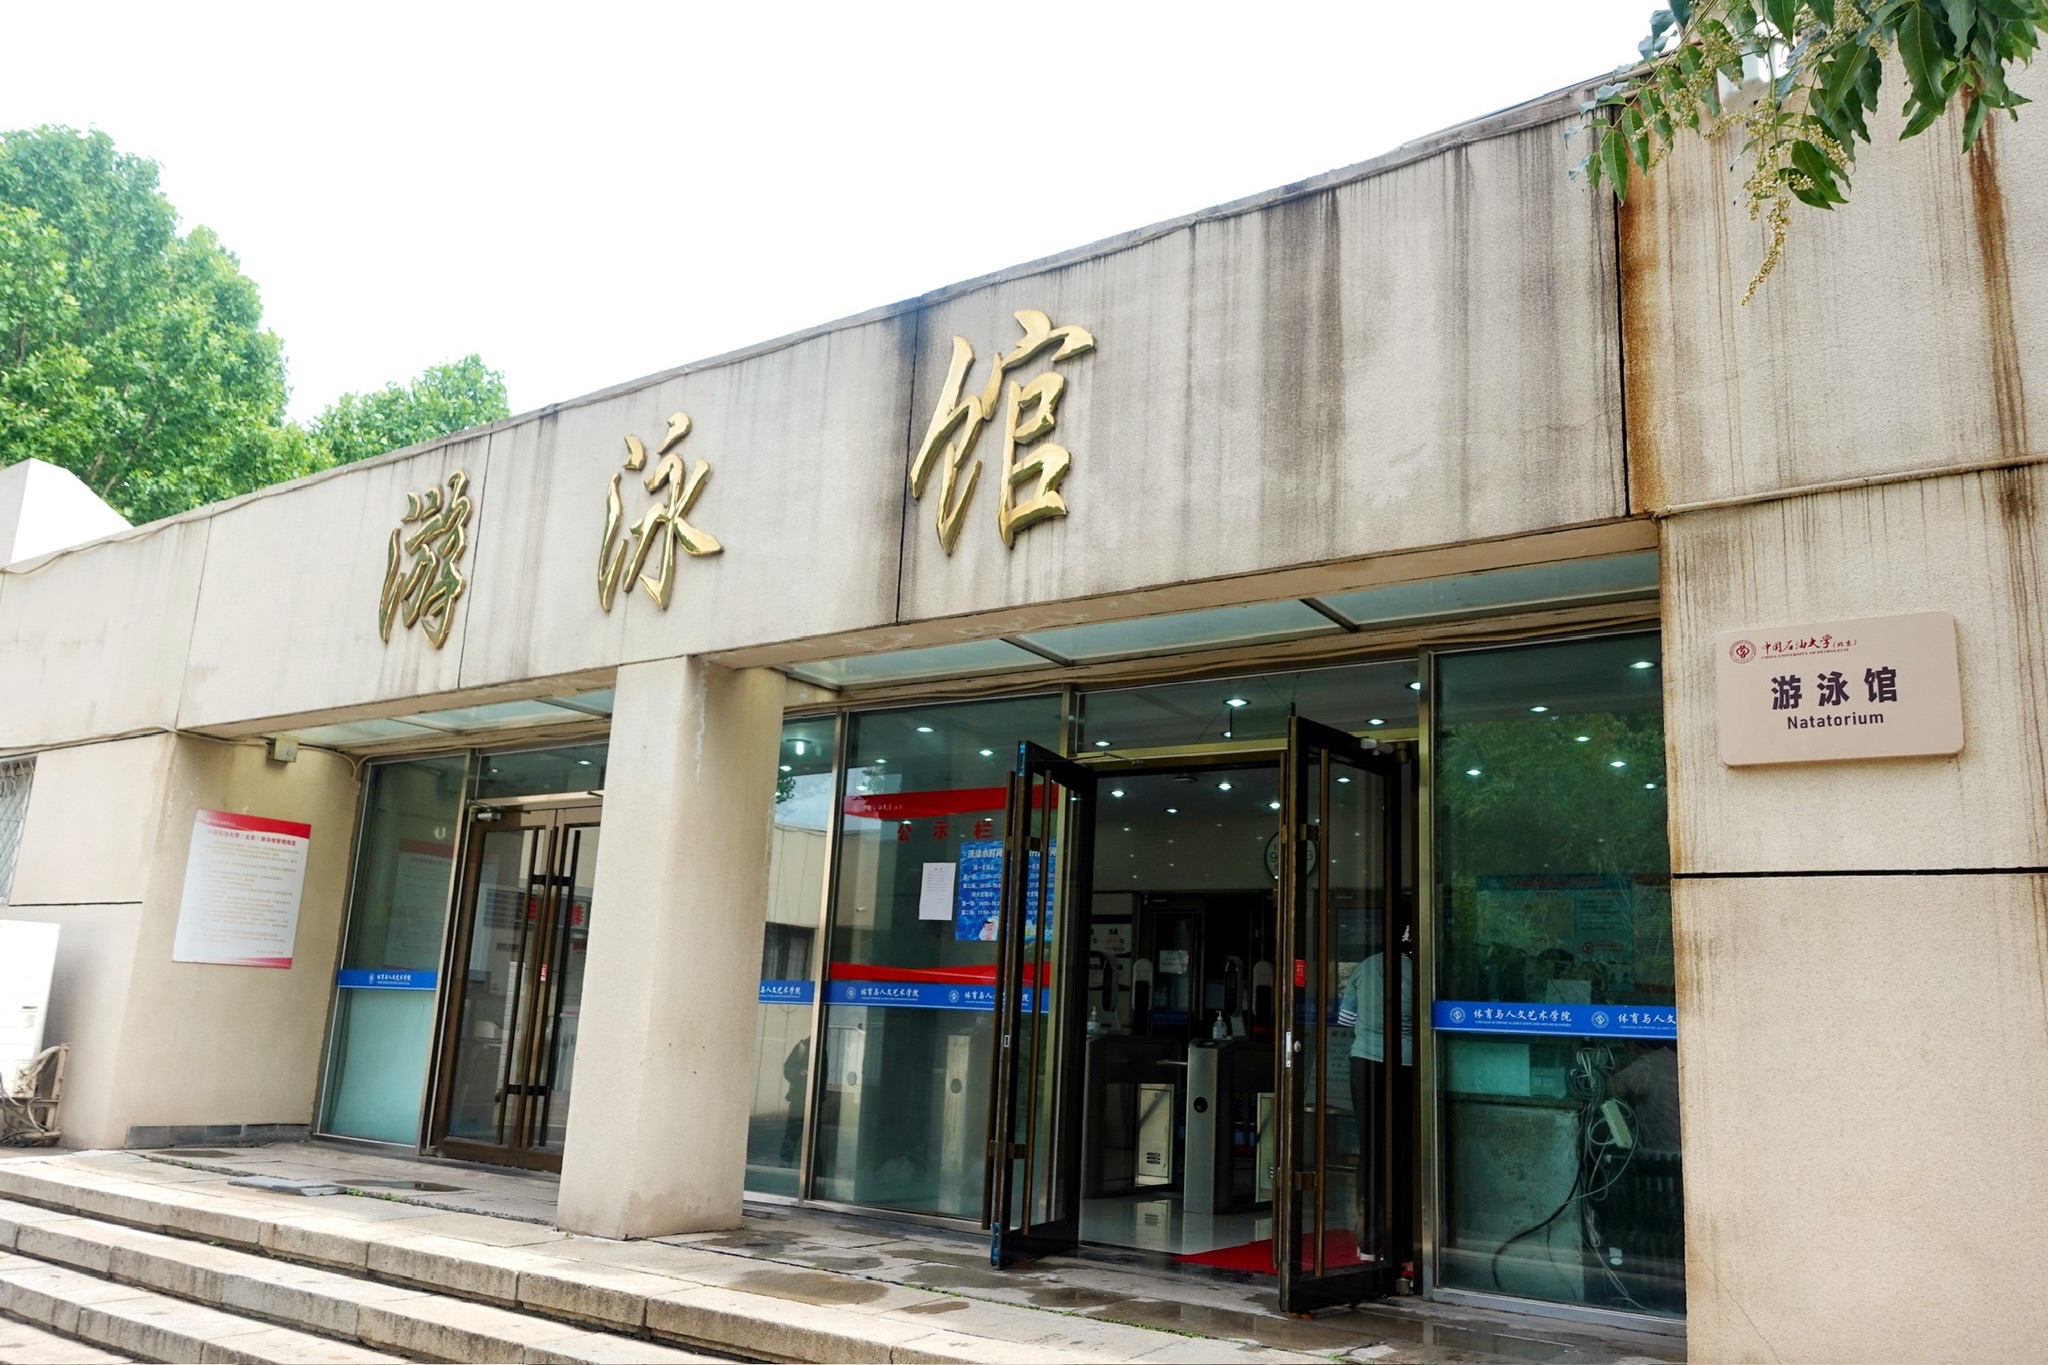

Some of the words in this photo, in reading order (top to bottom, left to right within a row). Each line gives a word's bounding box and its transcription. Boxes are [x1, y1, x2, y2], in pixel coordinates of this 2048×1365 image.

[1771, 666, 1897, 710] 游泳馆
[1787, 712, 1884, 729] Natatorium
[897, 821, 992, 842] 公示栏
[860, 987, 919, 998] 体育与人文艺术学院
[1473, 1008, 1572, 1022] 体育与人文艺术学院
